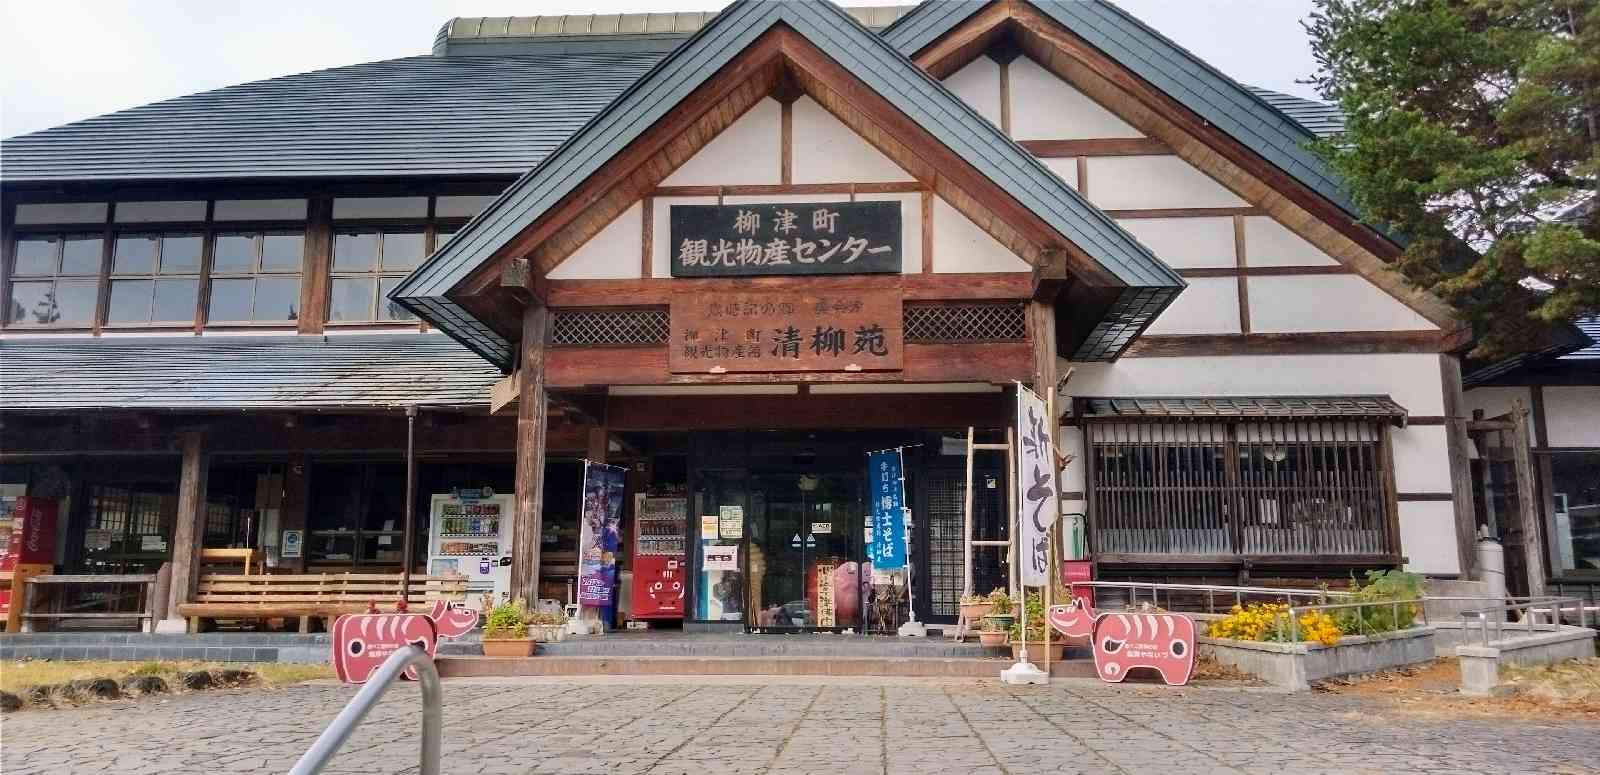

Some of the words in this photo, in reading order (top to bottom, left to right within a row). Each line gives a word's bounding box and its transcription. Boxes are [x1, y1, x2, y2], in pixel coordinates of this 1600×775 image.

[733, 208, 840, 235] 柳津町
[678, 237, 893, 267] 観光物産センター
[683, 328, 761, 343] 柳津町
[771, 324, 889, 360] 清柳苑
